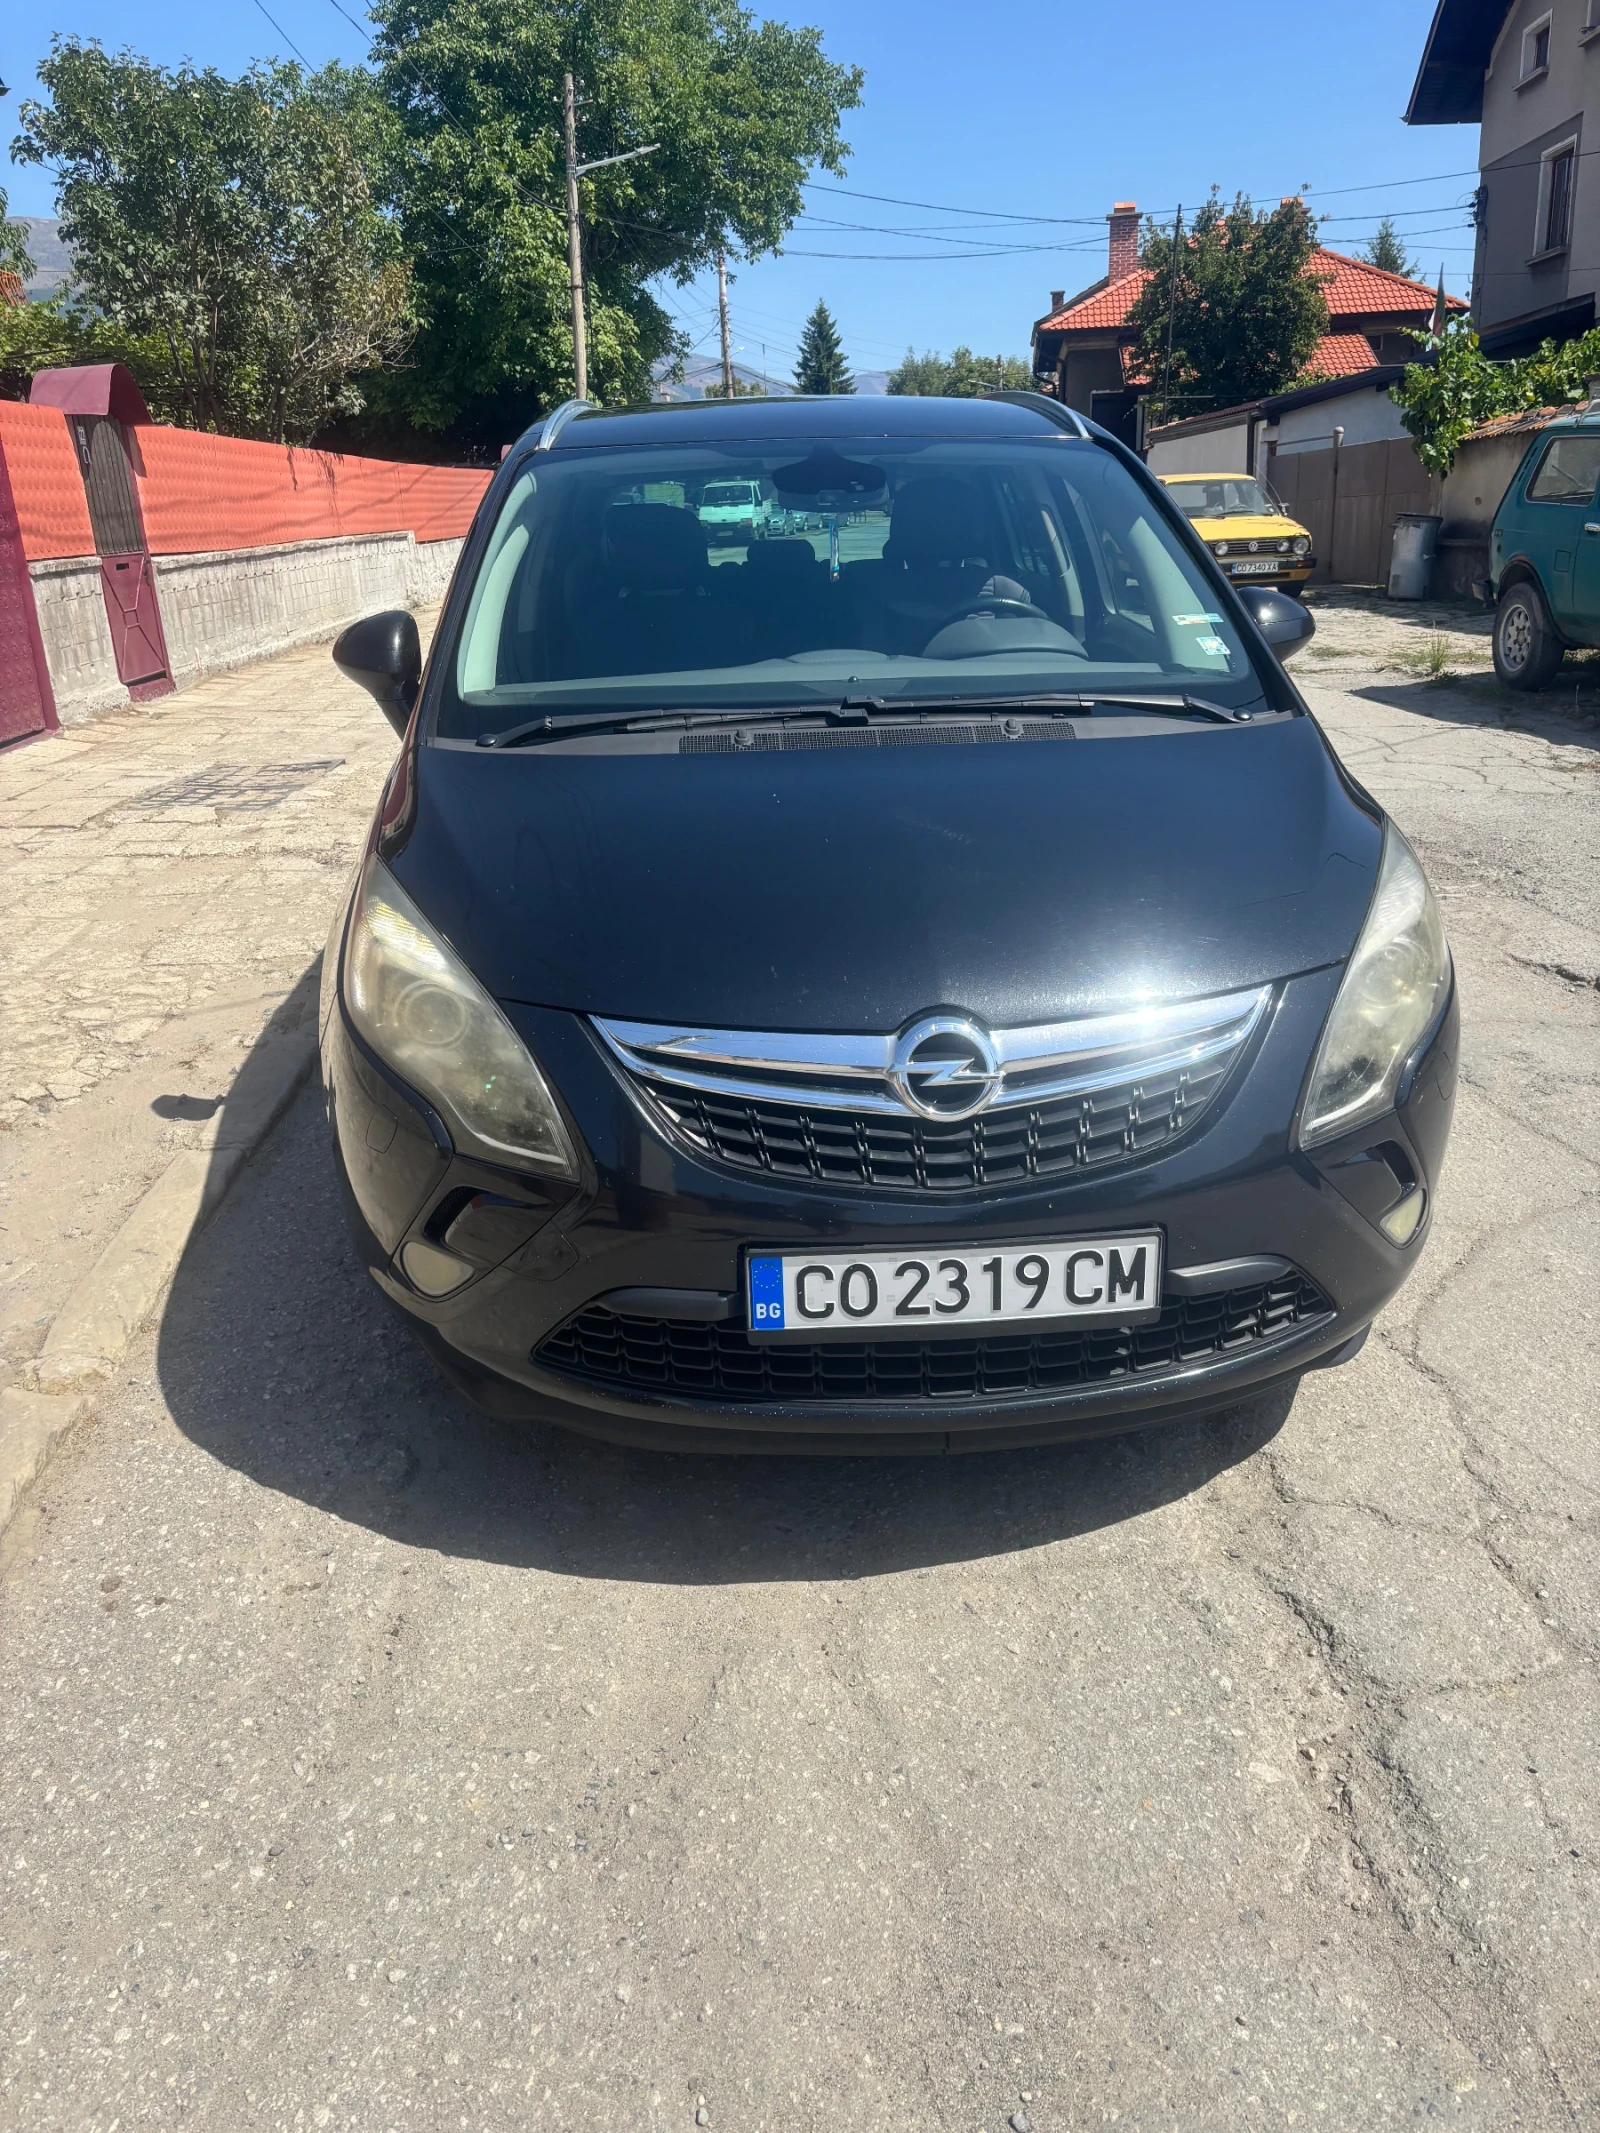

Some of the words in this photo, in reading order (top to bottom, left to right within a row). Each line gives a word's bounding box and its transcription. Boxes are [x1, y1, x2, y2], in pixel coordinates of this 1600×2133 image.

[1247, 563, 1266, 572] 7340
[1267, 562, 1277, 571] XA
[796, 1263, 879, 1319] CO
[894, 1254, 1050, 1317] 2319
[1065, 1246, 1148, 1306] CM
[756, 1303, 781, 1319] BG
